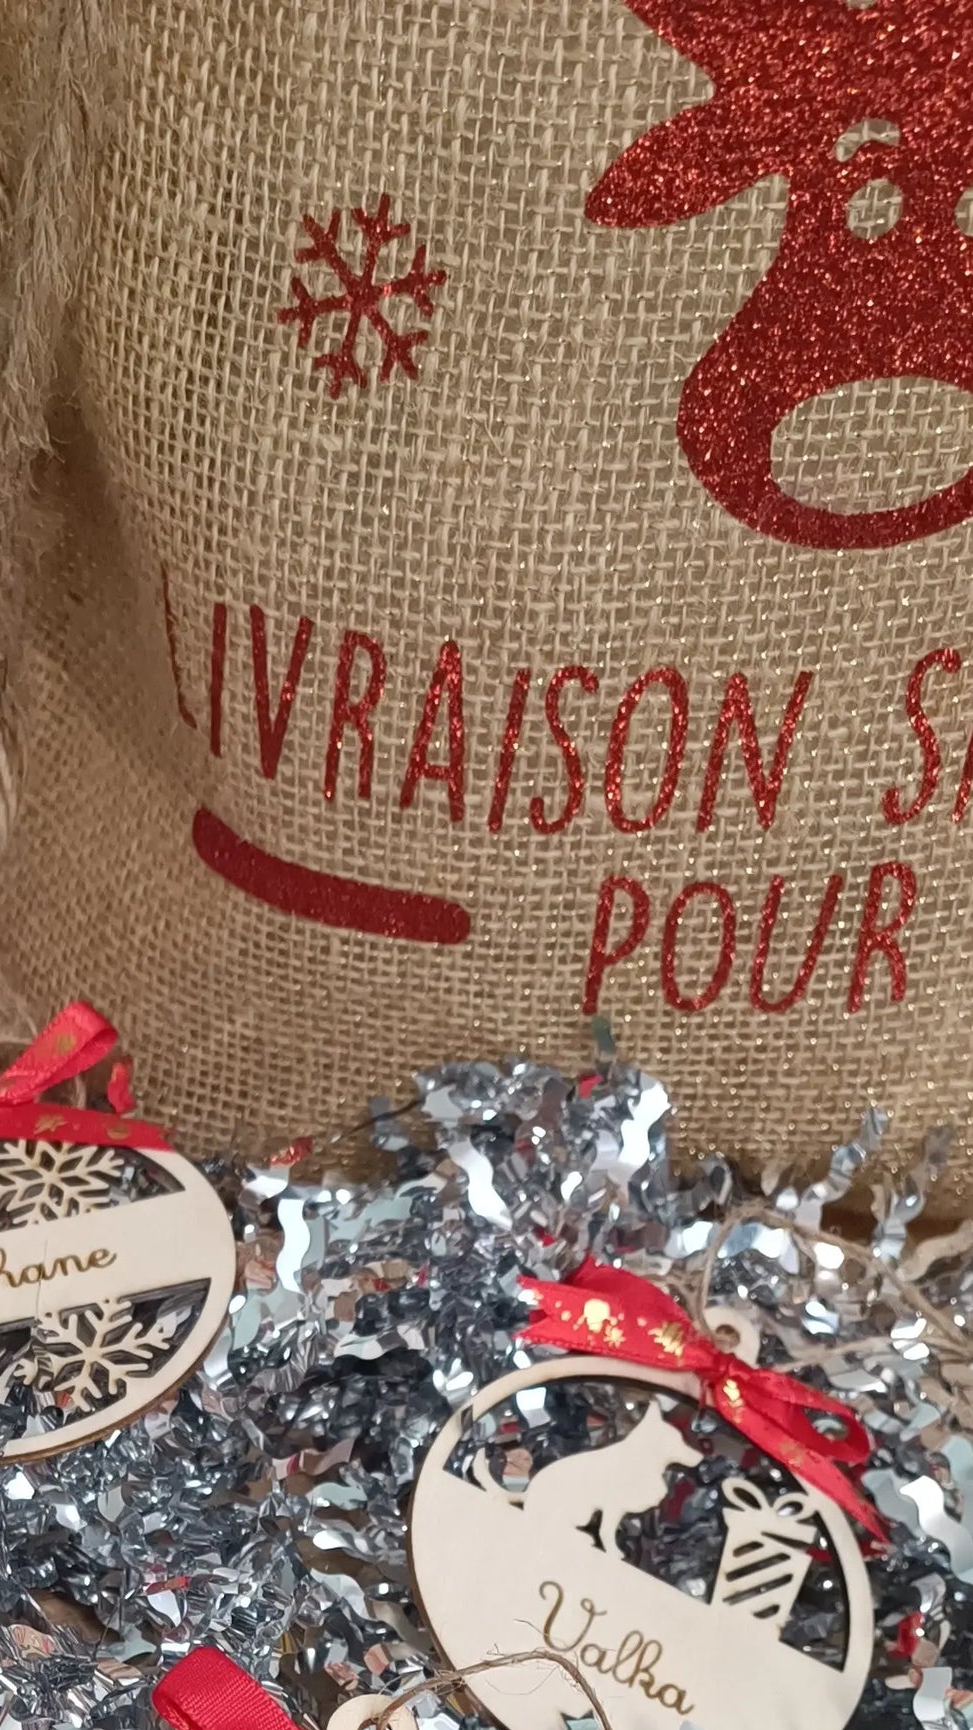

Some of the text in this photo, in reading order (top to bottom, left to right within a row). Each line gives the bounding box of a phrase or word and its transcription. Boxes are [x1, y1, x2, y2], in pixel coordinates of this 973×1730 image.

[160, 560, 813, 833] LIVRAISON
[882, 647, 973, 825] S
[582, 860, 918, 1016] POUR
[538, 1580, 696, 1716] Valka
